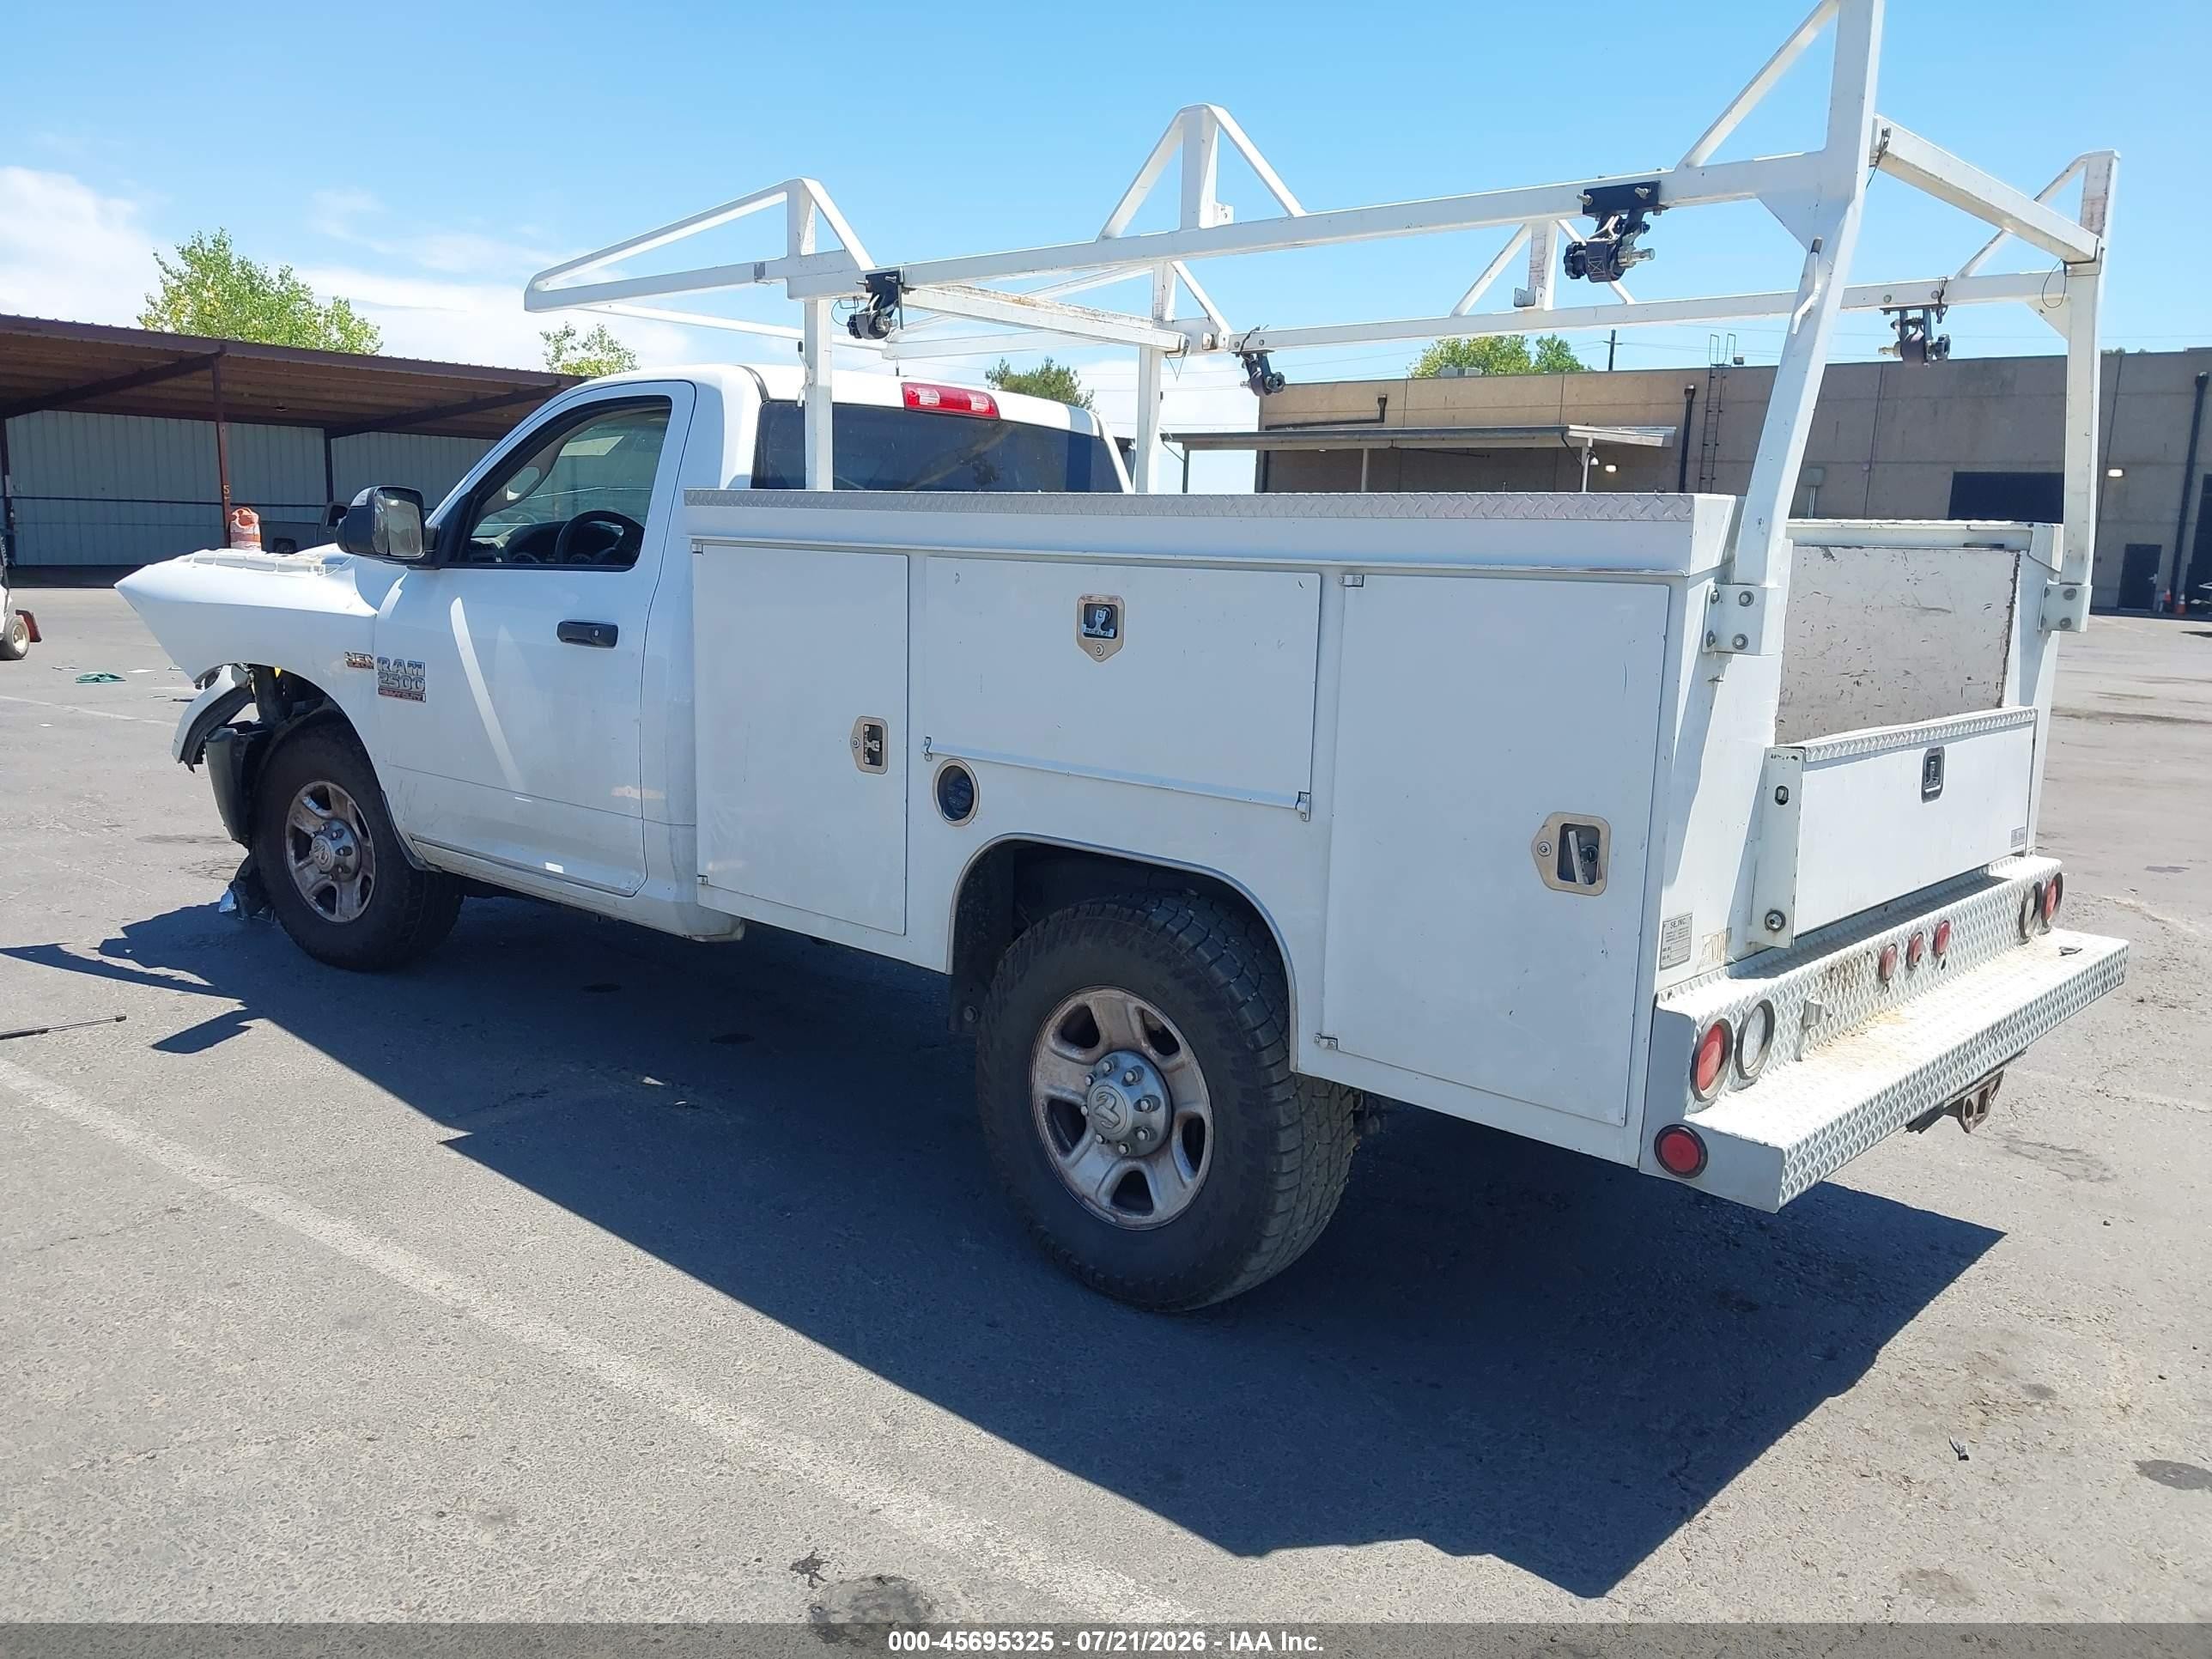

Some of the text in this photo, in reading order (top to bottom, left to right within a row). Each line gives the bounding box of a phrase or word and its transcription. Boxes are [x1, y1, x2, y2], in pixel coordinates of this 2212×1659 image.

[223, 484, 230, 495] 5
[377, 657, 426, 677] RAM
[378, 672, 426, 693] 2500
[402, 691, 422, 702] DUTY
